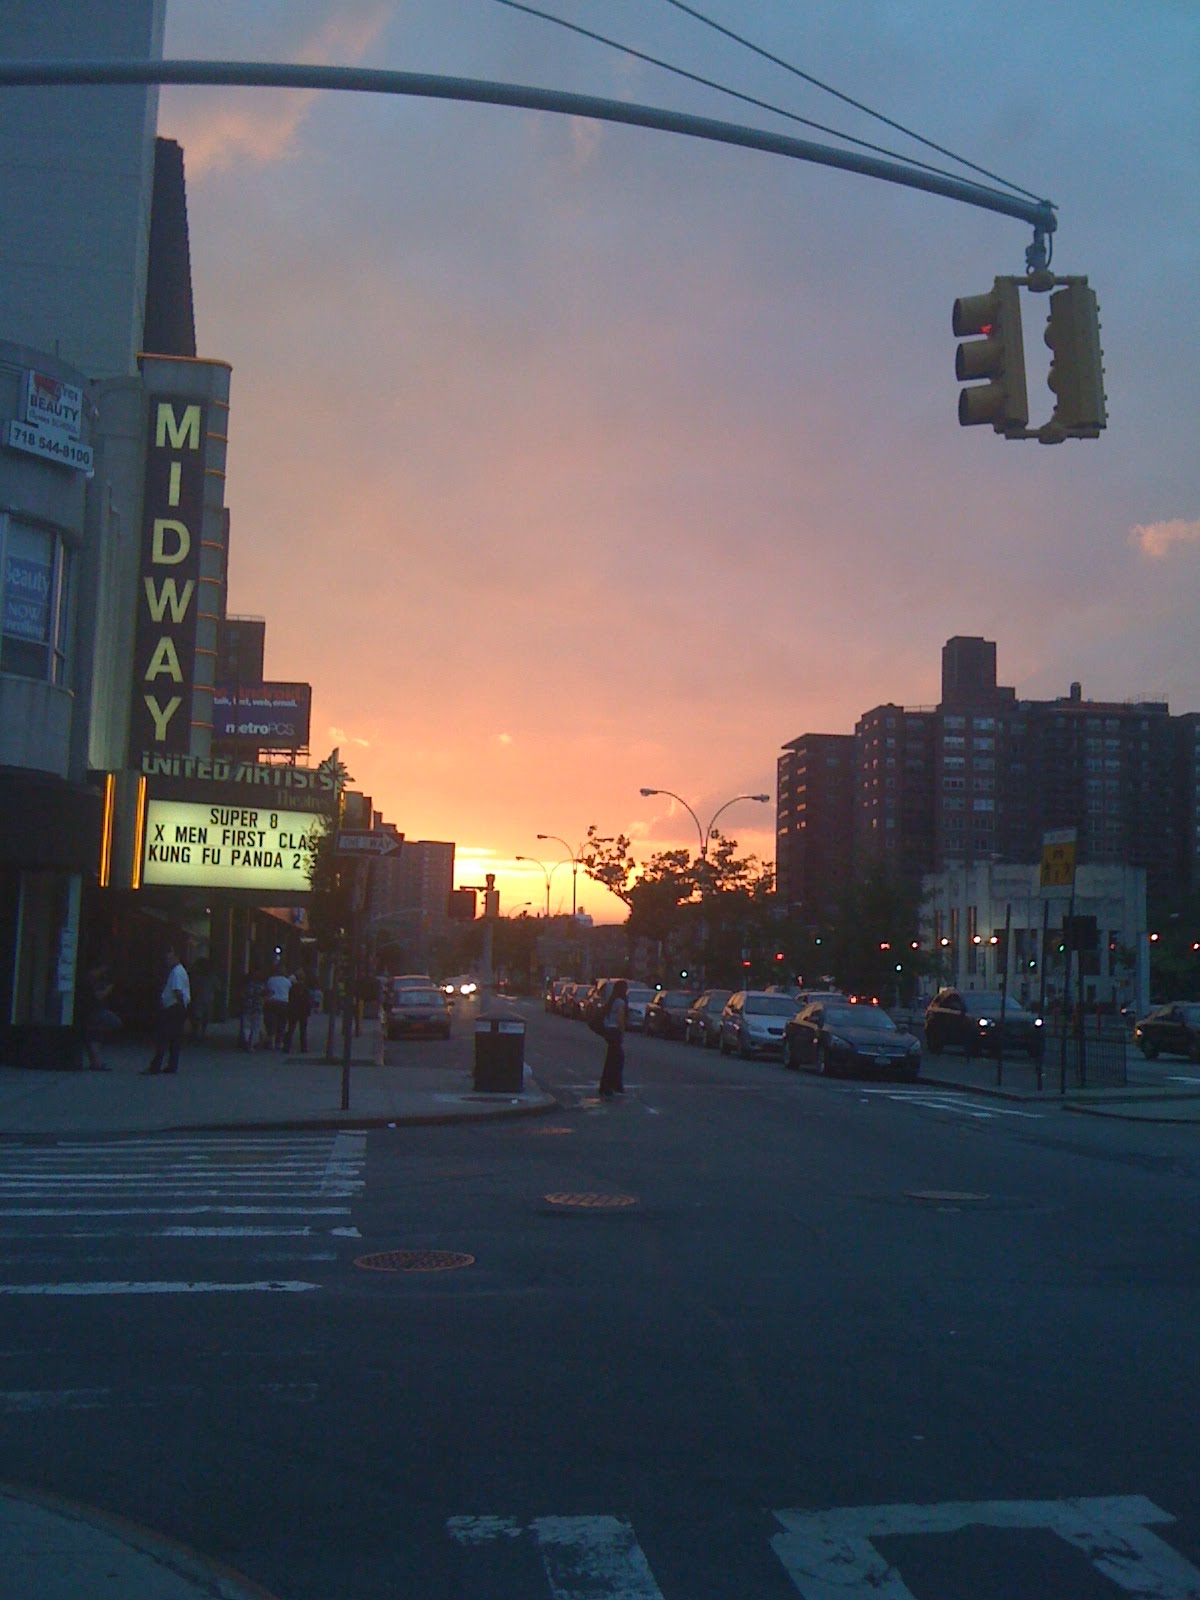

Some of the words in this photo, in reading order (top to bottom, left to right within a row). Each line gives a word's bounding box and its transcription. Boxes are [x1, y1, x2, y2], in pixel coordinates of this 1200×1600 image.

[30, 394, 79, 422] BEAUTY
[14, 427, 35, 446] 718
[144, 402, 202, 742] MIDWAY
[142, 751, 231, 781] UNITED
[234, 759, 334, 792] ARTISTS
[210, 808, 258, 829] SUPER
[269, 813, 278, 829] 8
[154, 824, 165, 842] X
[175, 826, 208, 845] MEN
[222, 829, 266, 848] FIRST
[148, 844, 190, 864] KUNG
[202, 848, 221, 865] FU
[231, 850, 283, 868] PANDA
[293, 853, 301, 869] 2
